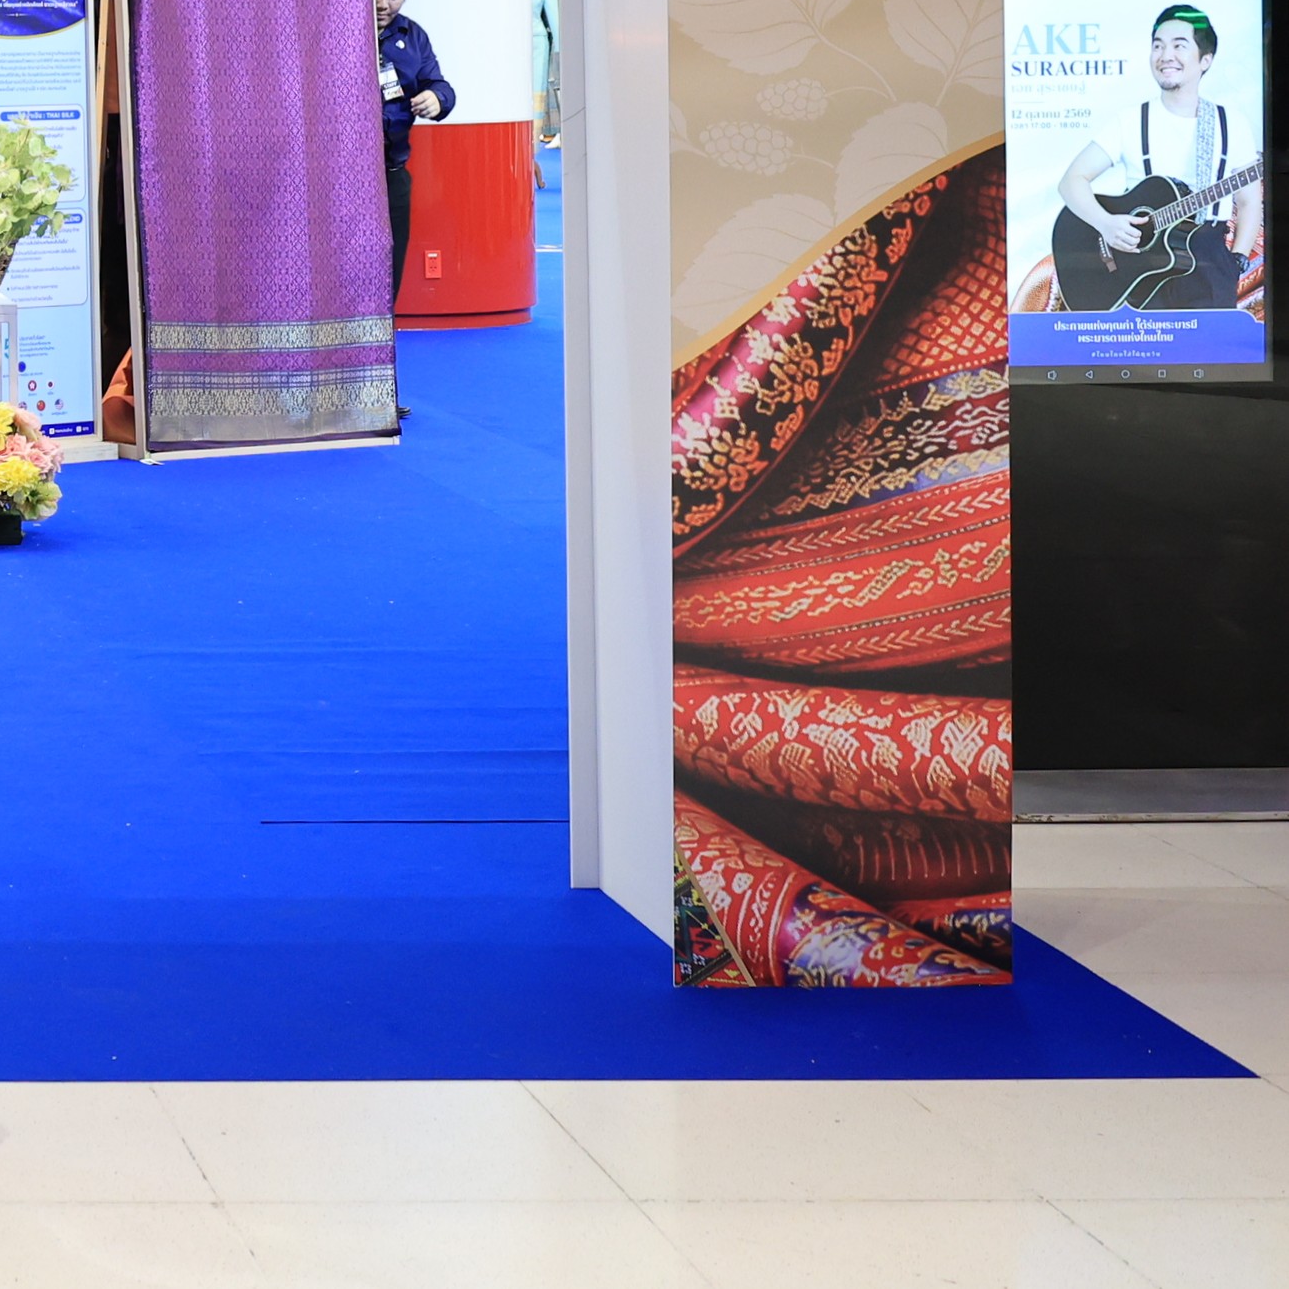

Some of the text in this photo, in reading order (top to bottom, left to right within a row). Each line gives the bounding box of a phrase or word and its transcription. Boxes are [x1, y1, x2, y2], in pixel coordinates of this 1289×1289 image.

[1012, 23, 1101, 56] AKE
[1010, 59, 1128, 77] SURACHET
[1011, 108, 1091, 122] 12 ตุลาคม 2569
[1054, 316, 1198, 333] ประกายแห่งคุณค่า ใต้ร่มพระบารมี
[1077, 330, 1174, 343] พระมารดาแห่งไหมไทย
